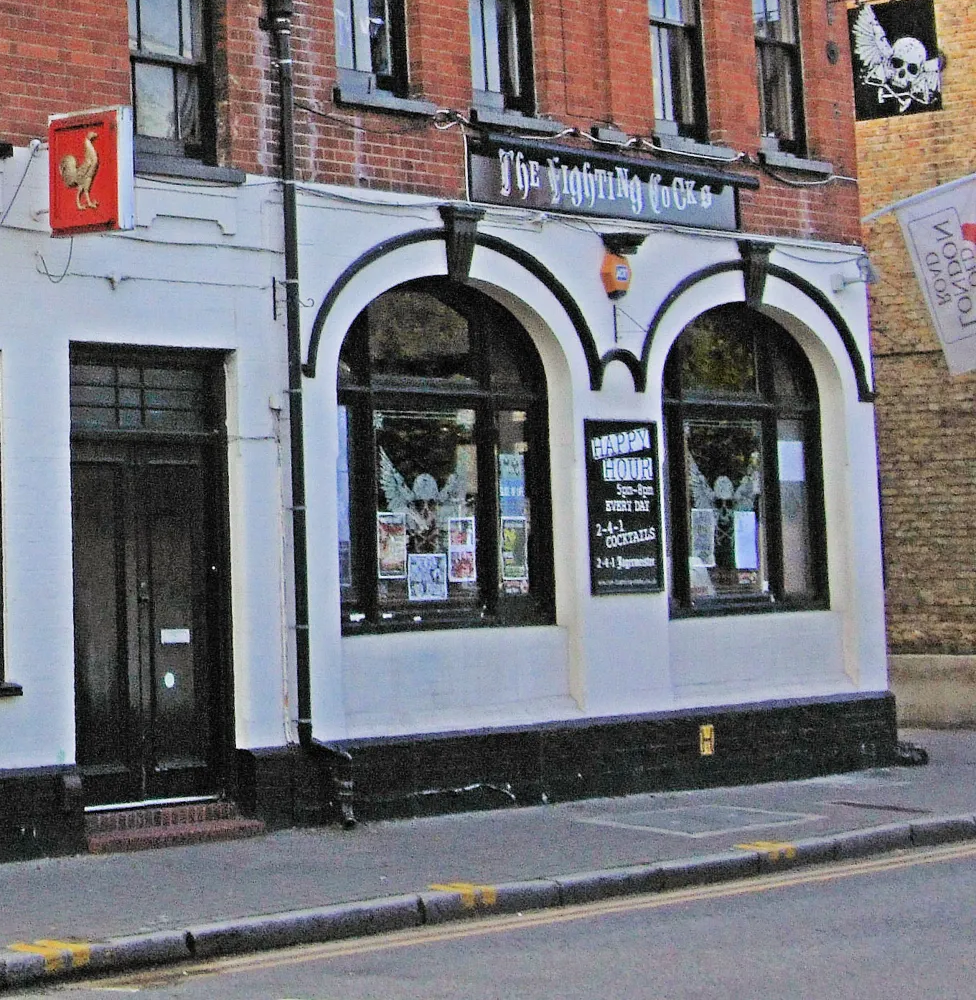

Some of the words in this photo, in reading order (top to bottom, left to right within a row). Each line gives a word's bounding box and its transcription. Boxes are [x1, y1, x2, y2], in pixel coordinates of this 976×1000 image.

[592, 428, 648, 458] HAPPY
[604, 458, 654, 480] HOUR
[605, 500, 632, 512] EVERY
[635, 500, 650, 512] DAY
[596, 520, 624, 536] 2-4-1
[606, 527, 656, 548] COCKTAILS
